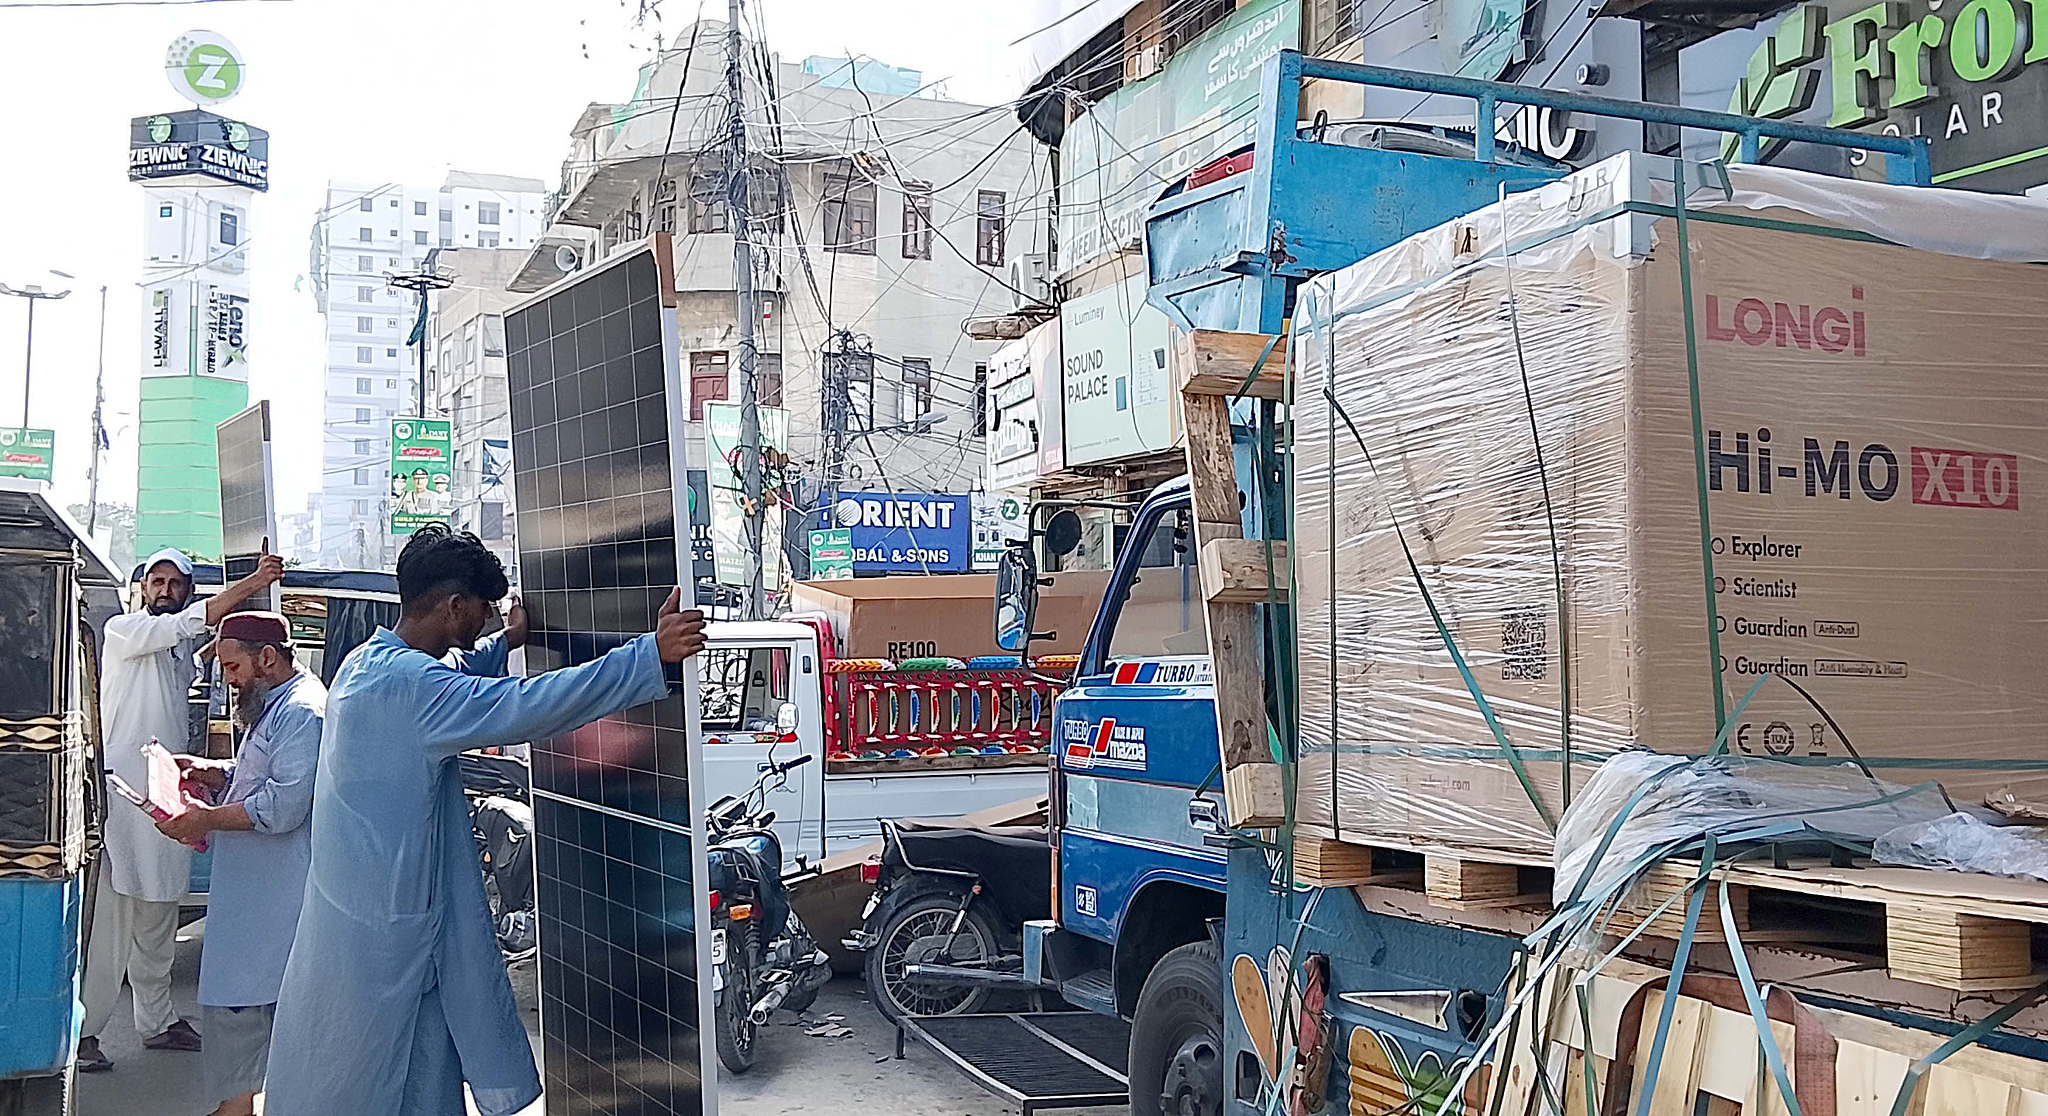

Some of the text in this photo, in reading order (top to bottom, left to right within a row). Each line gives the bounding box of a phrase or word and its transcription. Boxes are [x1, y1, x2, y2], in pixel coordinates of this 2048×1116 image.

[195, 53, 228, 90] Z
[130, 143, 188, 166] ZIEWNIC
[200, 144, 267, 179] ZIEWNIC
[153, 307, 163, 367] LI-WALL
[1067, 348, 1104, 378] SOUND
[1068, 374, 1108, 404] PALACE
[1708, 427, 2011, 507] Hi-MO X10
[837, 499, 955, 529] ORIENT
[891, 548, 904, 563] &
[906, 547, 949, 563] SONS
[1732, 535, 1802, 561] Explorer
[1733, 577, 1797, 599] Scientist
[1734, 616, 1855, 638] Guardian Anti-Dust
[888, 641, 937, 661] RE100
[1156, 663, 1196, 683] TURBO
[1735, 656, 1809, 677] Guardian
[1064, 719, 1089, 742] TURBO
